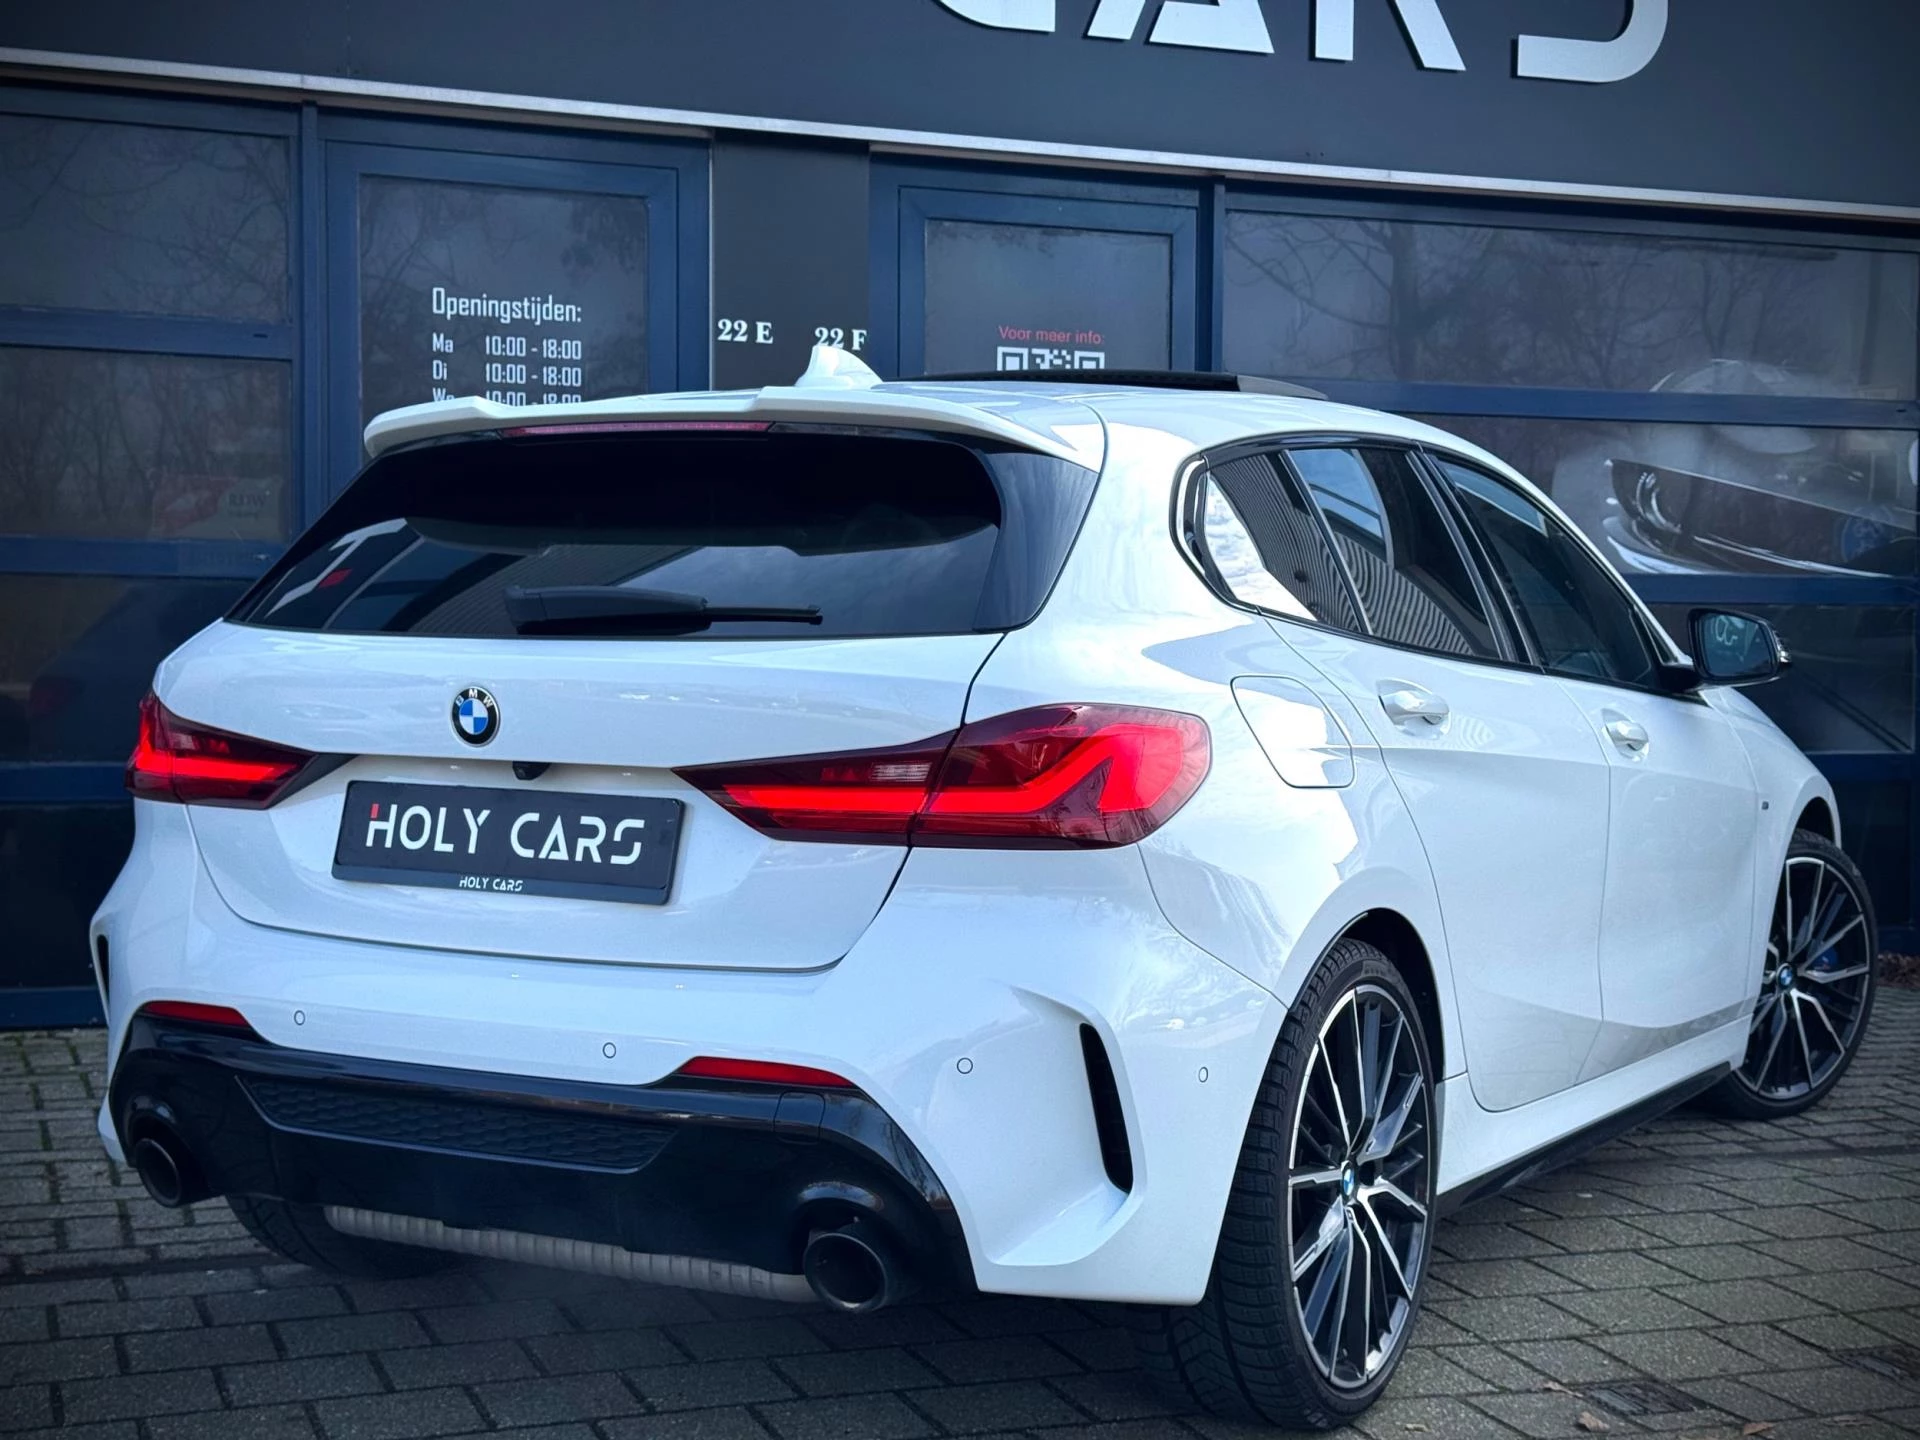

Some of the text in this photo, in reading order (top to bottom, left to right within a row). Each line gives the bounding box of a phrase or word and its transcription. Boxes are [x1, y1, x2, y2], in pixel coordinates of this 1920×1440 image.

[432, 287, 582, 326] Openingstijden:
[717, 318, 774, 344] 22 E
[814, 327, 868, 351] 22 F
[998, 325, 1105, 345] Voor meer info:
[432, 332, 454, 353] Ma
[485, 335, 526, 357] 10:00
[543, 338, 582, 360] 18:00
[432, 360, 448, 381] Di
[485, 362, 526, 385] 10:00
[543, 366, 582, 387] 18:00
[455, 688, 494, 708] BMW
[365, 803, 645, 866] HOLY CARS
[459, 875, 524, 892] HOLY CARS
